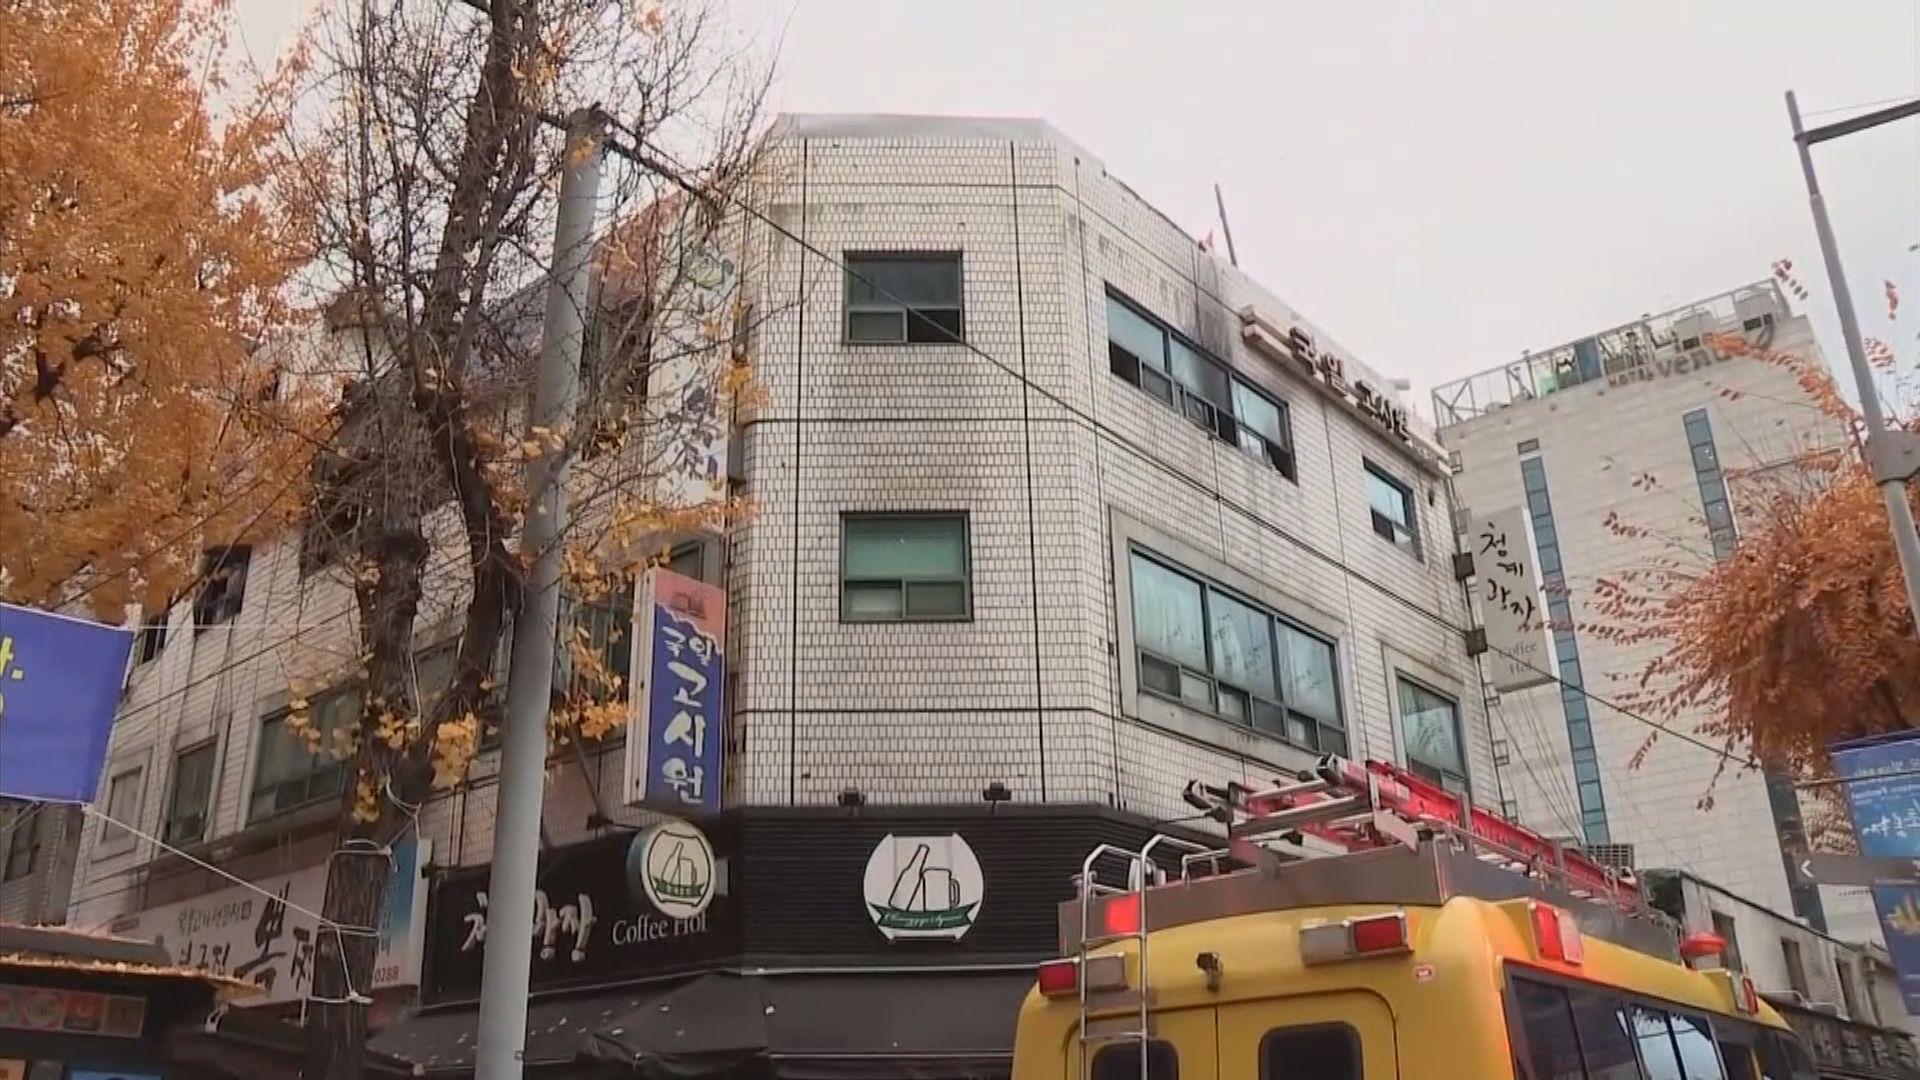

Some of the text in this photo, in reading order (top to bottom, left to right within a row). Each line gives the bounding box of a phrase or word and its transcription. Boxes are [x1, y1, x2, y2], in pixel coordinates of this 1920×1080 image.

[1288, 326, 1347, 398] 국일
[661, 624, 713, 667] 국일
[662, 660, 709, 804] 고시원
[612, 914, 669, 946] Coffee
